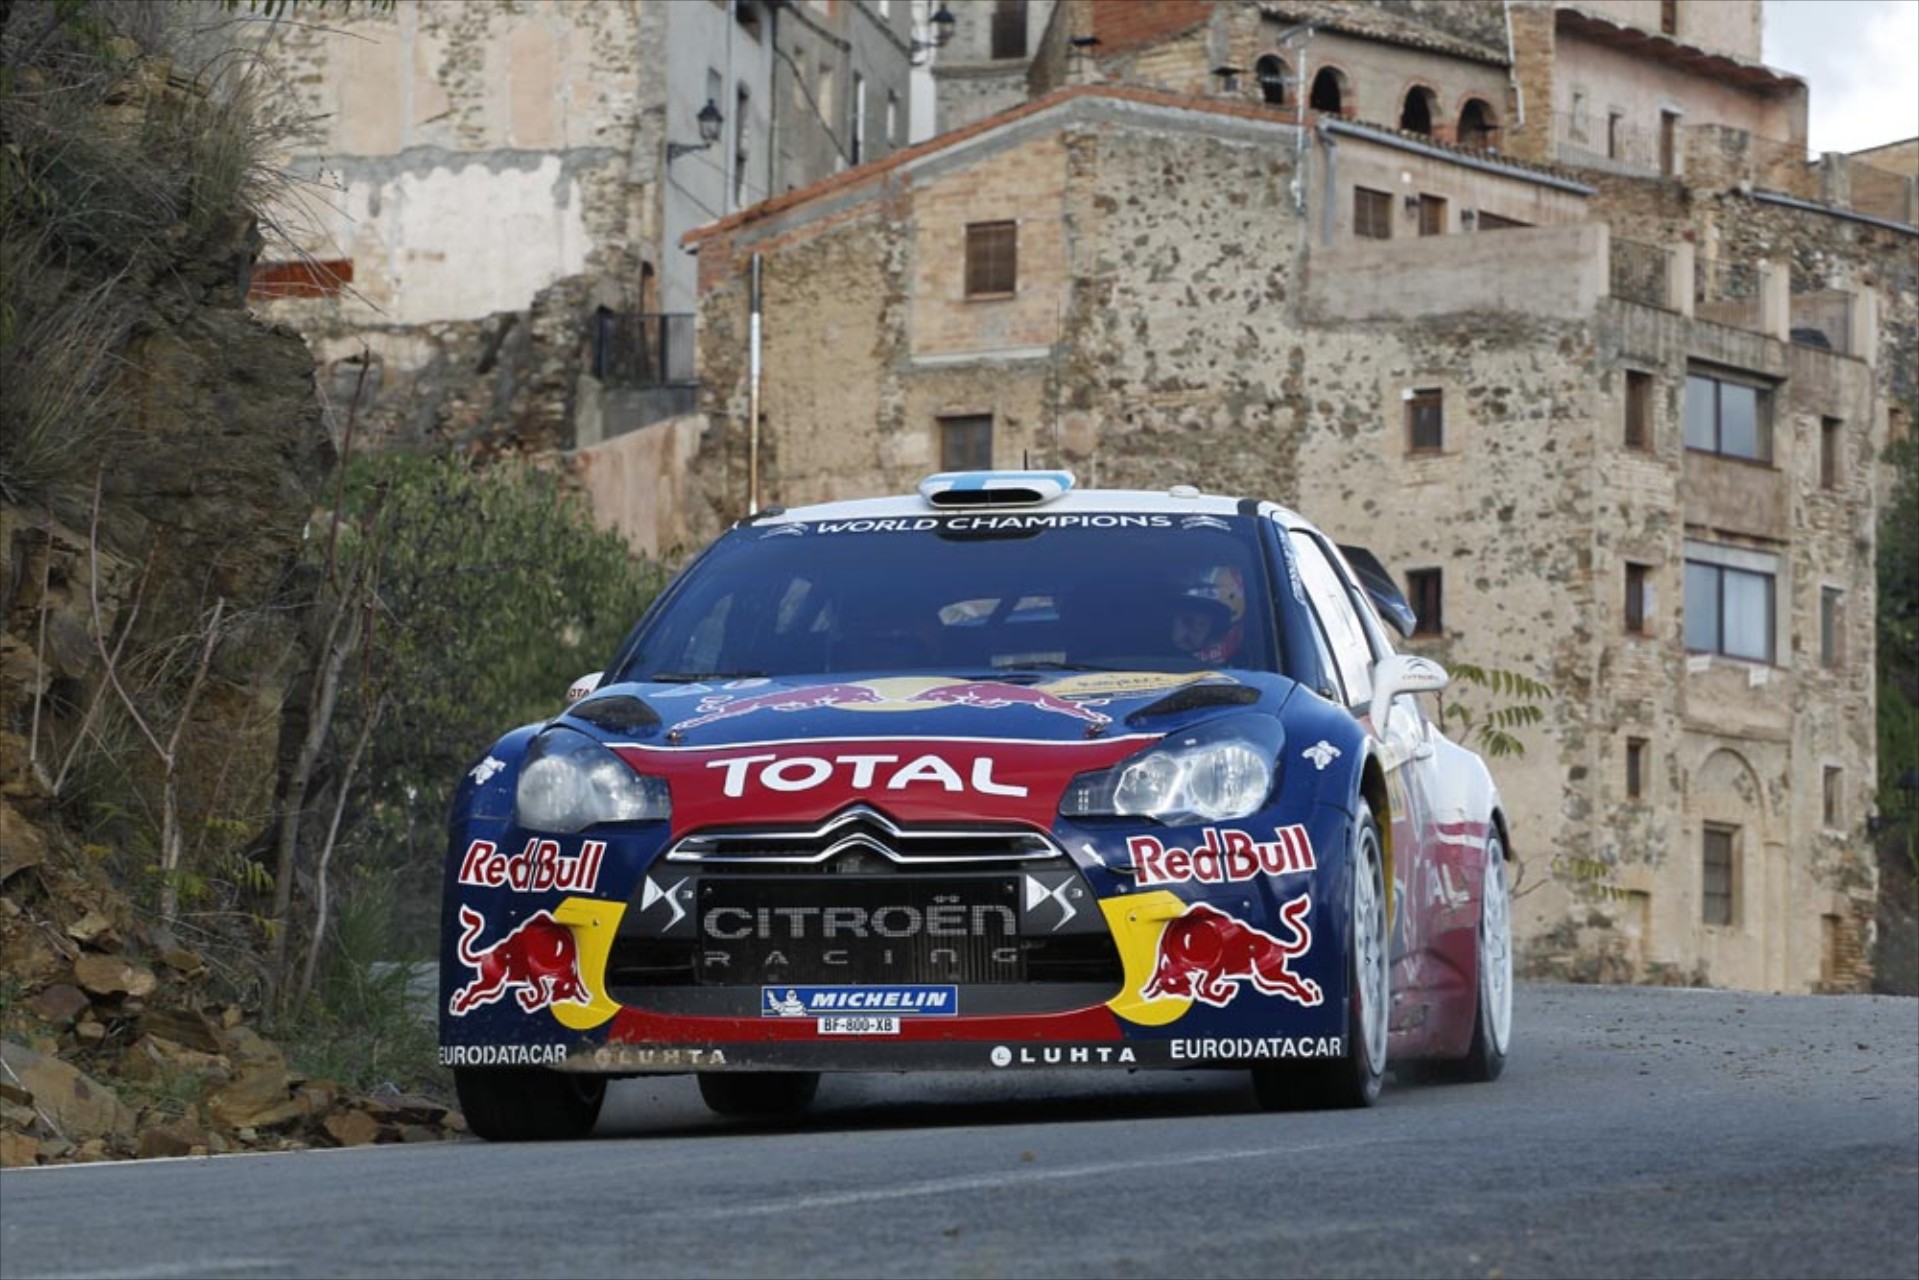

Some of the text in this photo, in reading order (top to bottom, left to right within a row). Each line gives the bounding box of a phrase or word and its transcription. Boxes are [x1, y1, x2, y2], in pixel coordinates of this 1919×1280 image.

[816, 515, 1172, 534] WORLD CHAMPIONS
[706, 753, 1028, 798] TOTAL
[1126, 823, 1317, 887] Red Bull
[458, 838, 607, 893] Red Bull
[703, 948, 1018, 966] RACING
[811, 991, 948, 1008] MICHELIN
[824, 1017, 894, 1032] BF-800-XB
[619, 1048, 727, 1065] LUHTA
[1020, 1047, 1137, 1063] LUHTA
[1169, 1036, 1342, 1060] EURODATACAR
